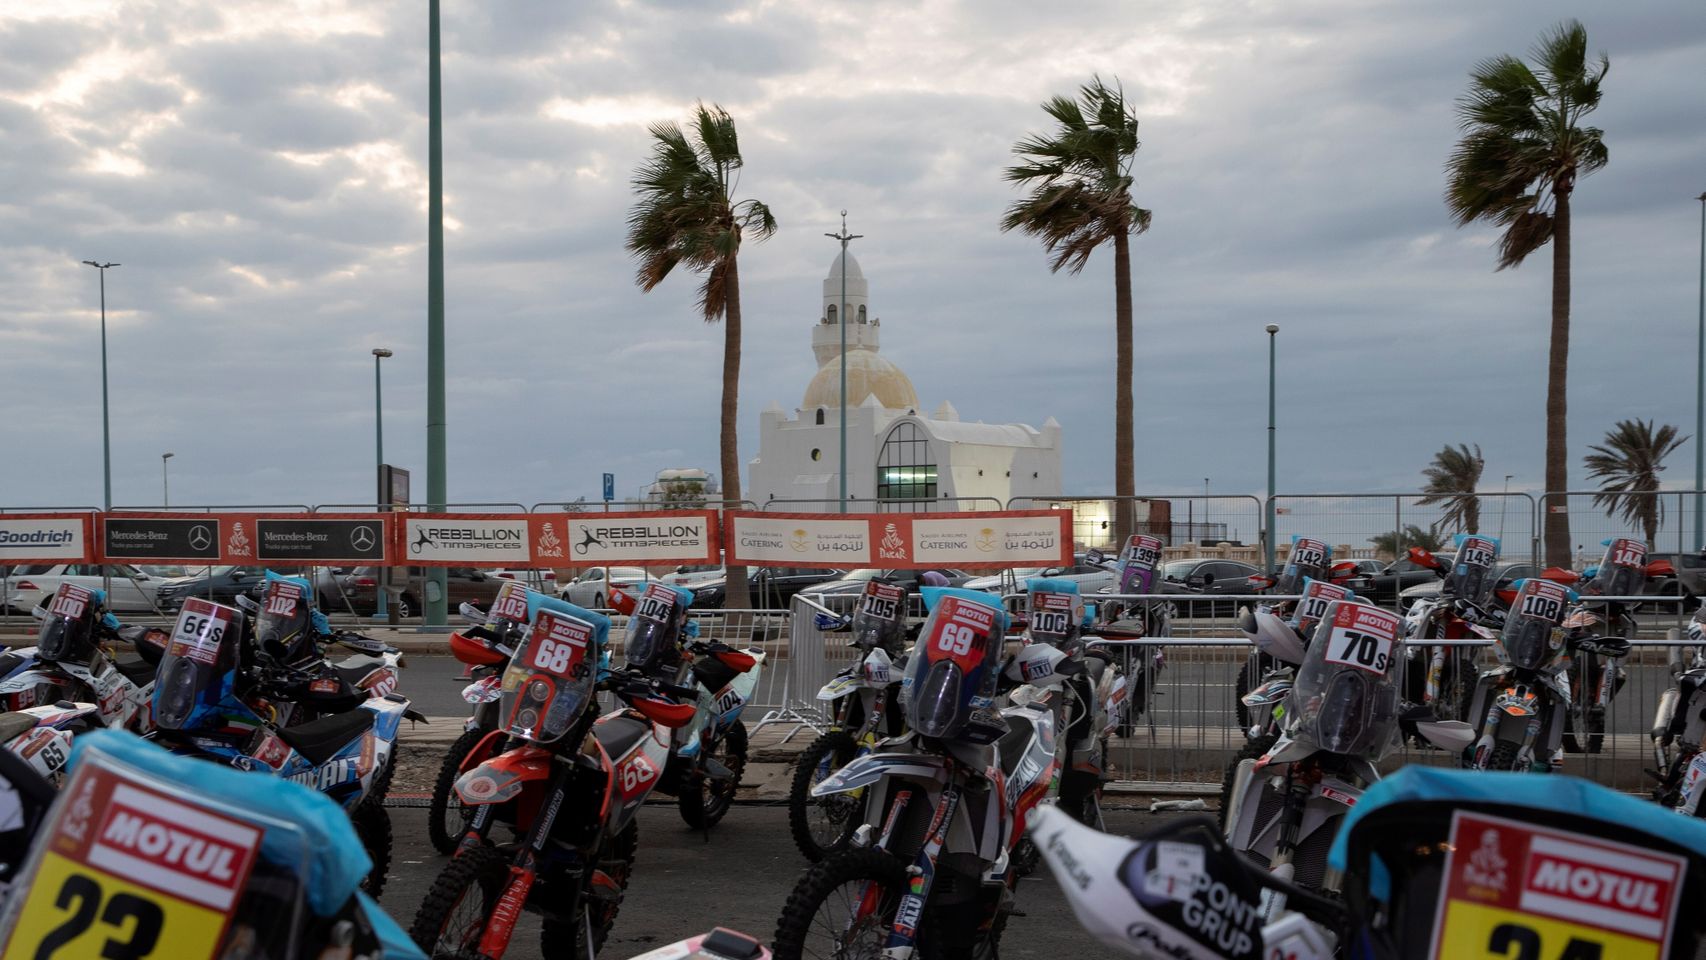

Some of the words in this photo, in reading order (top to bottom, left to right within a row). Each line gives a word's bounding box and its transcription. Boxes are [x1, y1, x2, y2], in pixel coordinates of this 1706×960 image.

[111, 531, 168, 540] Mercedes-Benz
[264, 532, 328, 541] Mercedes-Benz
[740, 538, 783, 549] CATERING
[919, 540, 968, 550] CATERING
[1131, 547, 1153, 562] 139
[1297, 550, 1321, 566] 142
[1467, 550, 1490, 566] 143
[267, 596, 296, 616] 102
[640, 599, 667, 620] 104
[866, 597, 894, 618] 105
[956, 607, 990, 623] MOTUL
[1524, 596, 1558, 619] 108
[553, 623, 585, 639] MOTUL
[1035, 613, 1065, 632] 106
[1358, 613, 1393, 631] MOTUL
[938, 623, 974, 656] 69
[534, 639, 572, 673] 68
[40, 741, 65, 771] 65
[105, 811, 237, 883] MOTUL
[1532, 860, 1658, 912] MOTUL
